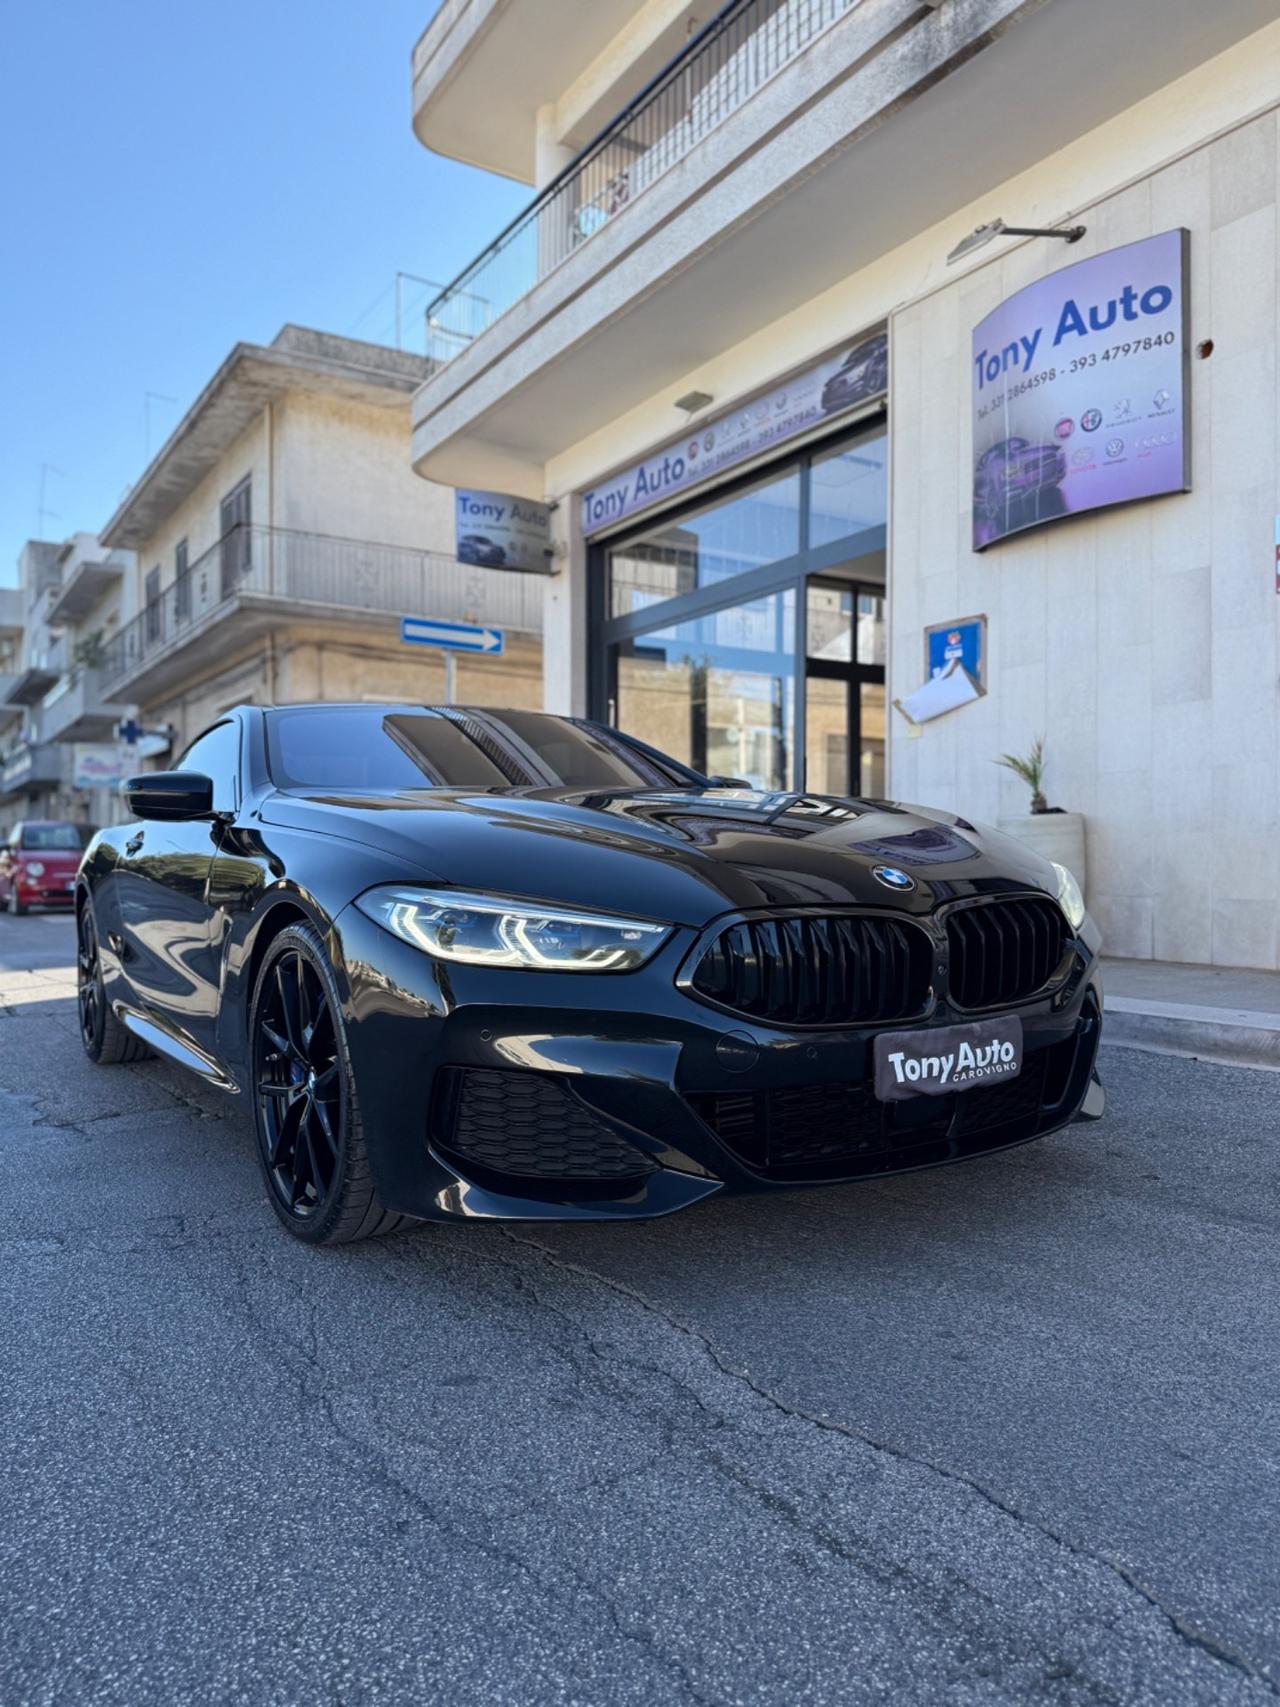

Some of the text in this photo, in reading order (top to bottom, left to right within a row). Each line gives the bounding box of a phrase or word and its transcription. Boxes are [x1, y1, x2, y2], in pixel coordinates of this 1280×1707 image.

[975, 285, 1173, 390] Tony Auto
[1007, 368, 1056, 401] 2864598
[1069, 353, 1097, 374] 393
[1101, 331, 1175, 362] 4797840
[458, 496, 547, 527] Tony Auto
[584, 455, 685, 524] Tony Auto
[952, 1061, 1018, 1083] CAROVIGNO
